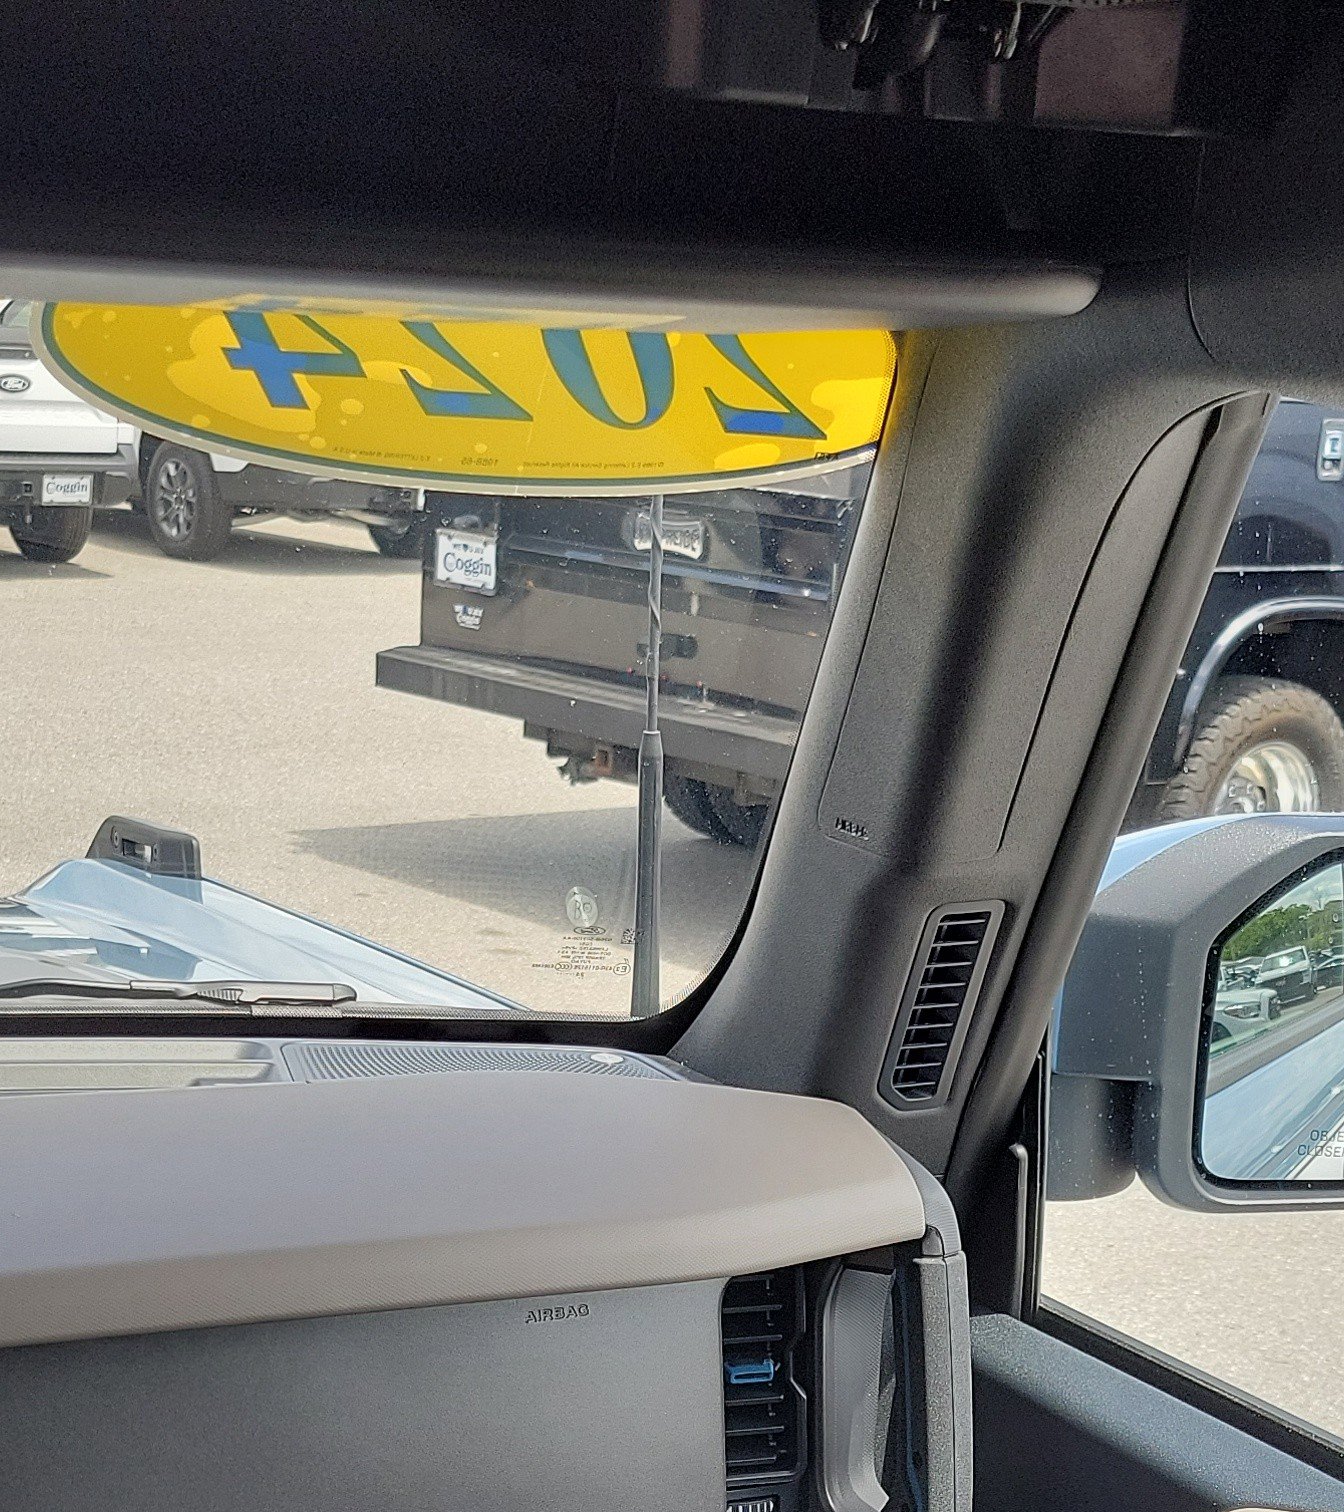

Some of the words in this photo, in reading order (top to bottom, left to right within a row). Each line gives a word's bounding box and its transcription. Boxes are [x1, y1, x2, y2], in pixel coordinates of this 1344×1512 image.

[46, 480, 89, 497] Coggin
[443, 551, 493, 578] Coggin
[524, 1303, 590, 1324] AIRBAG
